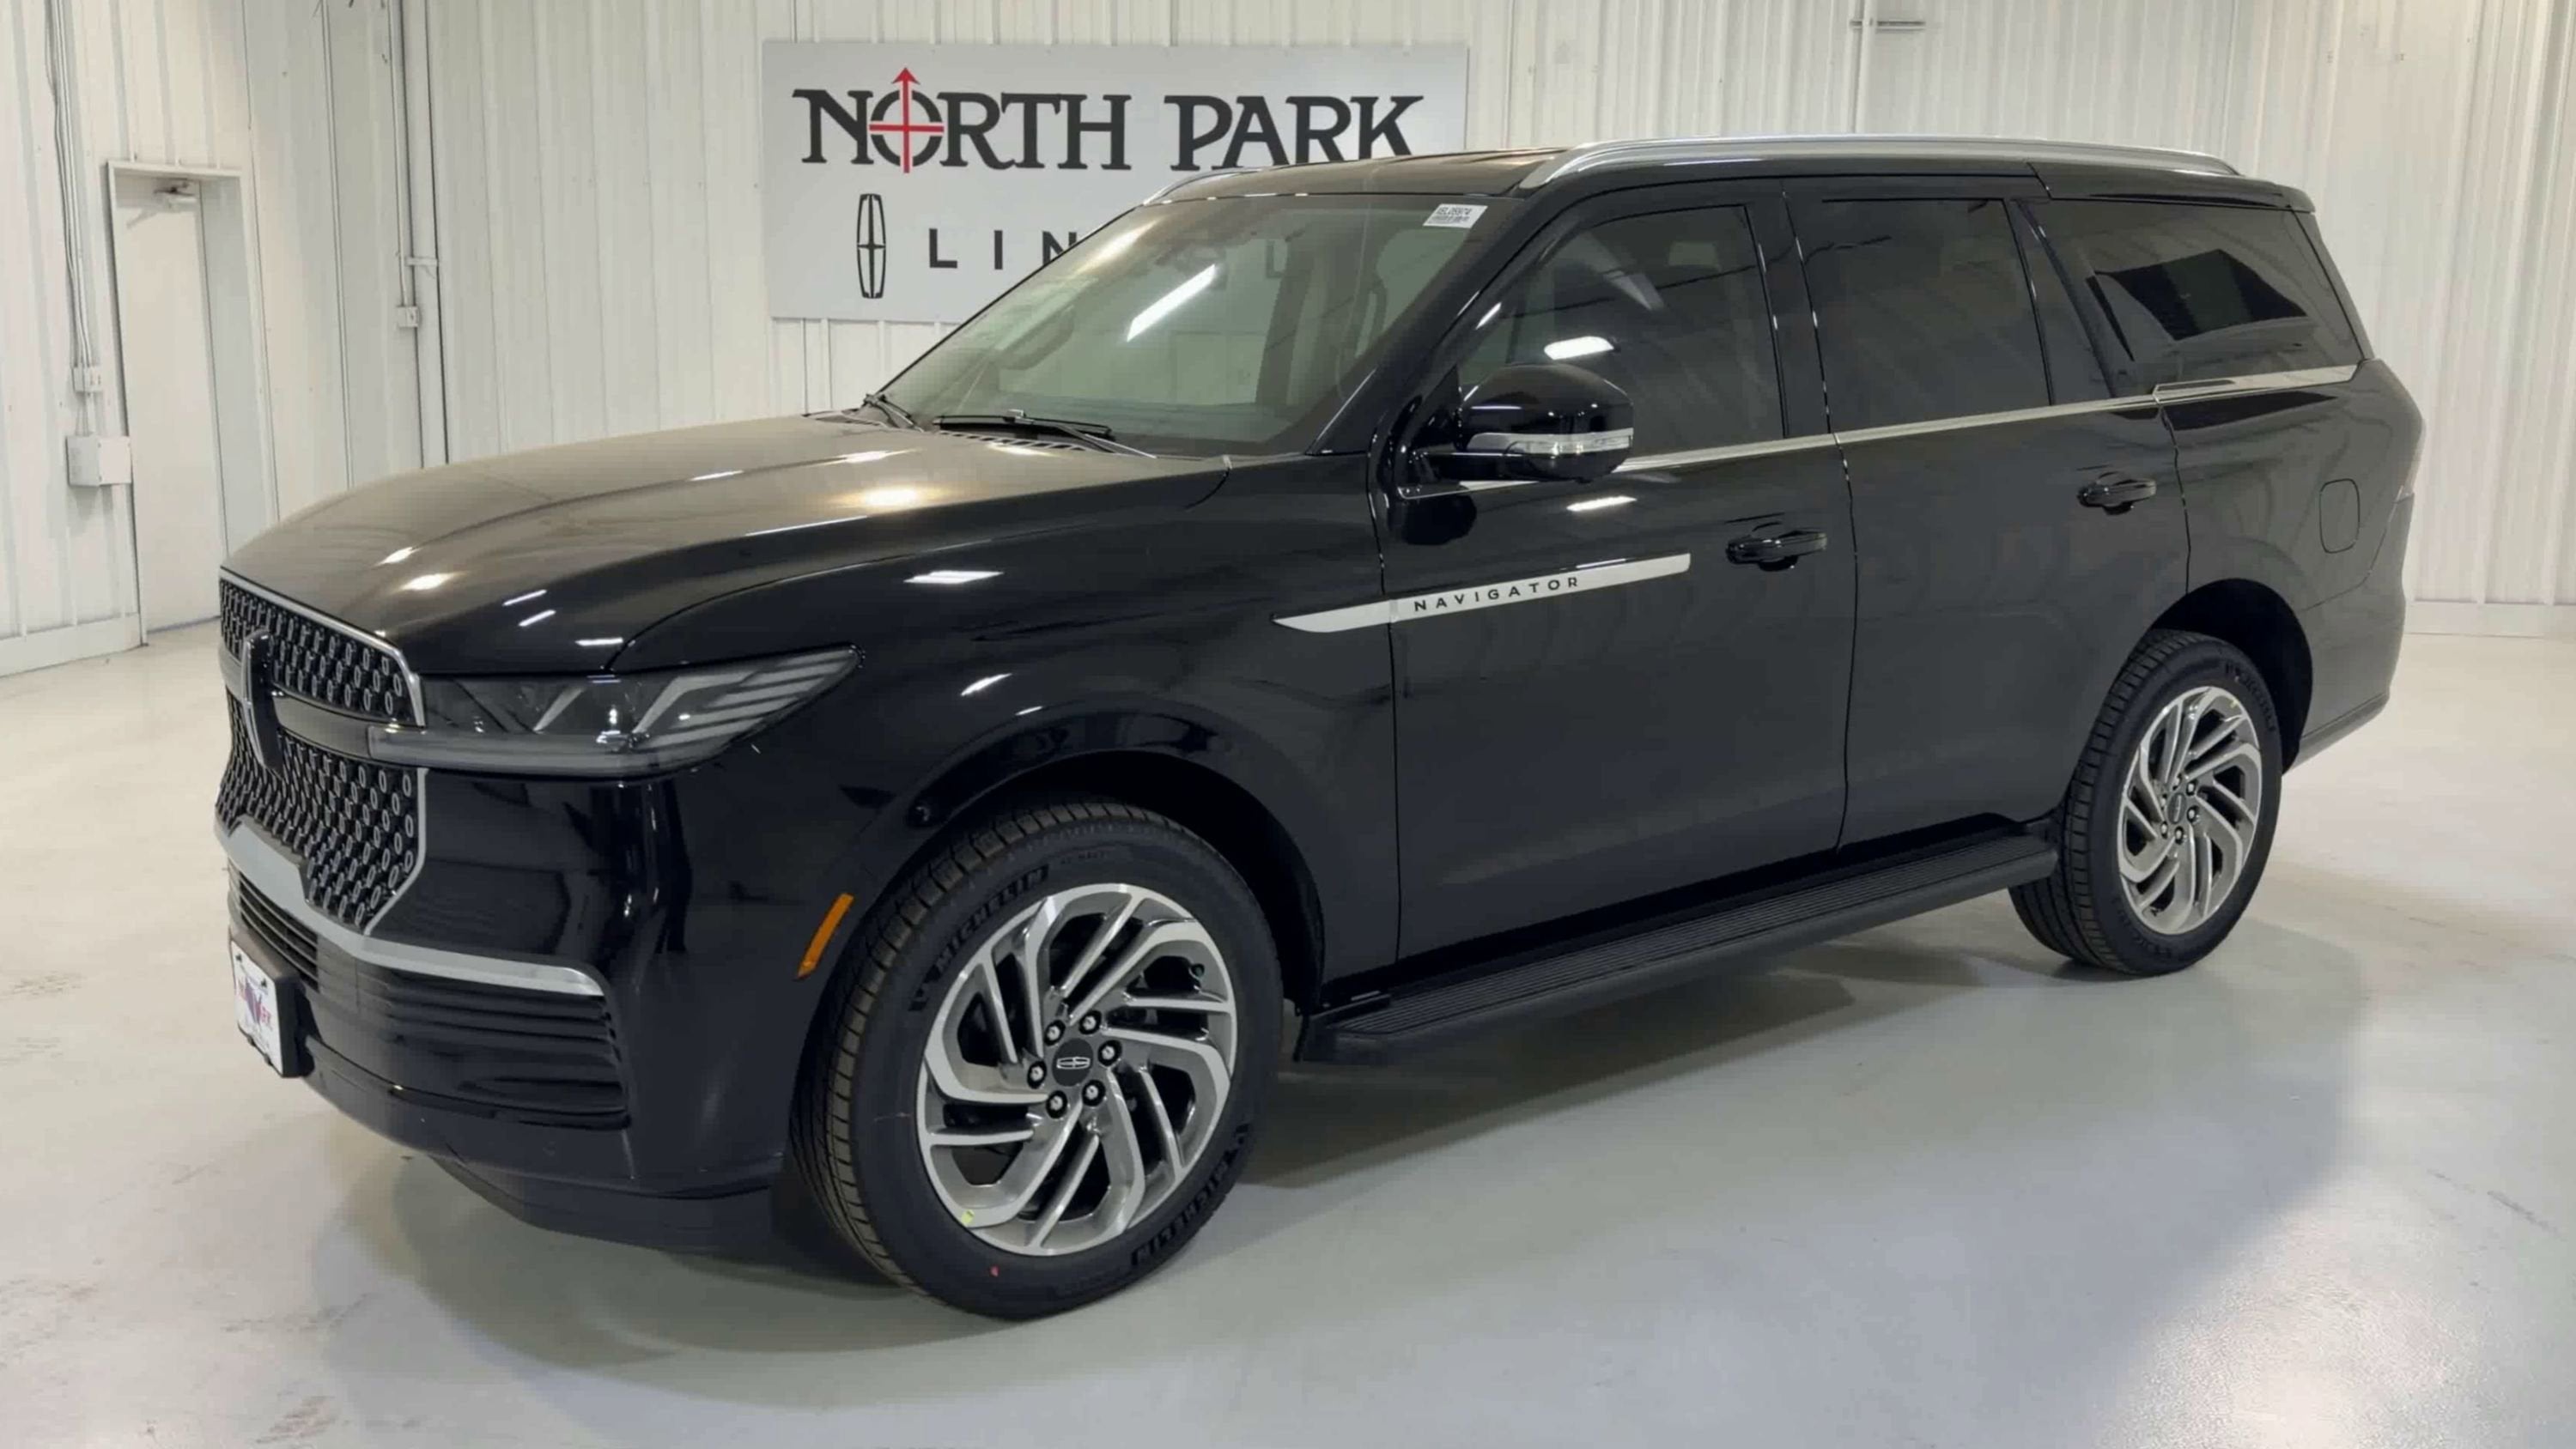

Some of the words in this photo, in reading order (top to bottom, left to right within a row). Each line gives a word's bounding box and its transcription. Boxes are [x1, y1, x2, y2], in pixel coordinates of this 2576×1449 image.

[792, 88, 1133, 172] NORTH
[1163, 94, 1424, 171] PARK
[1413, 576, 1578, 612] NAVIGATOR
[933, 864, 1049, 975] MICHELIN
